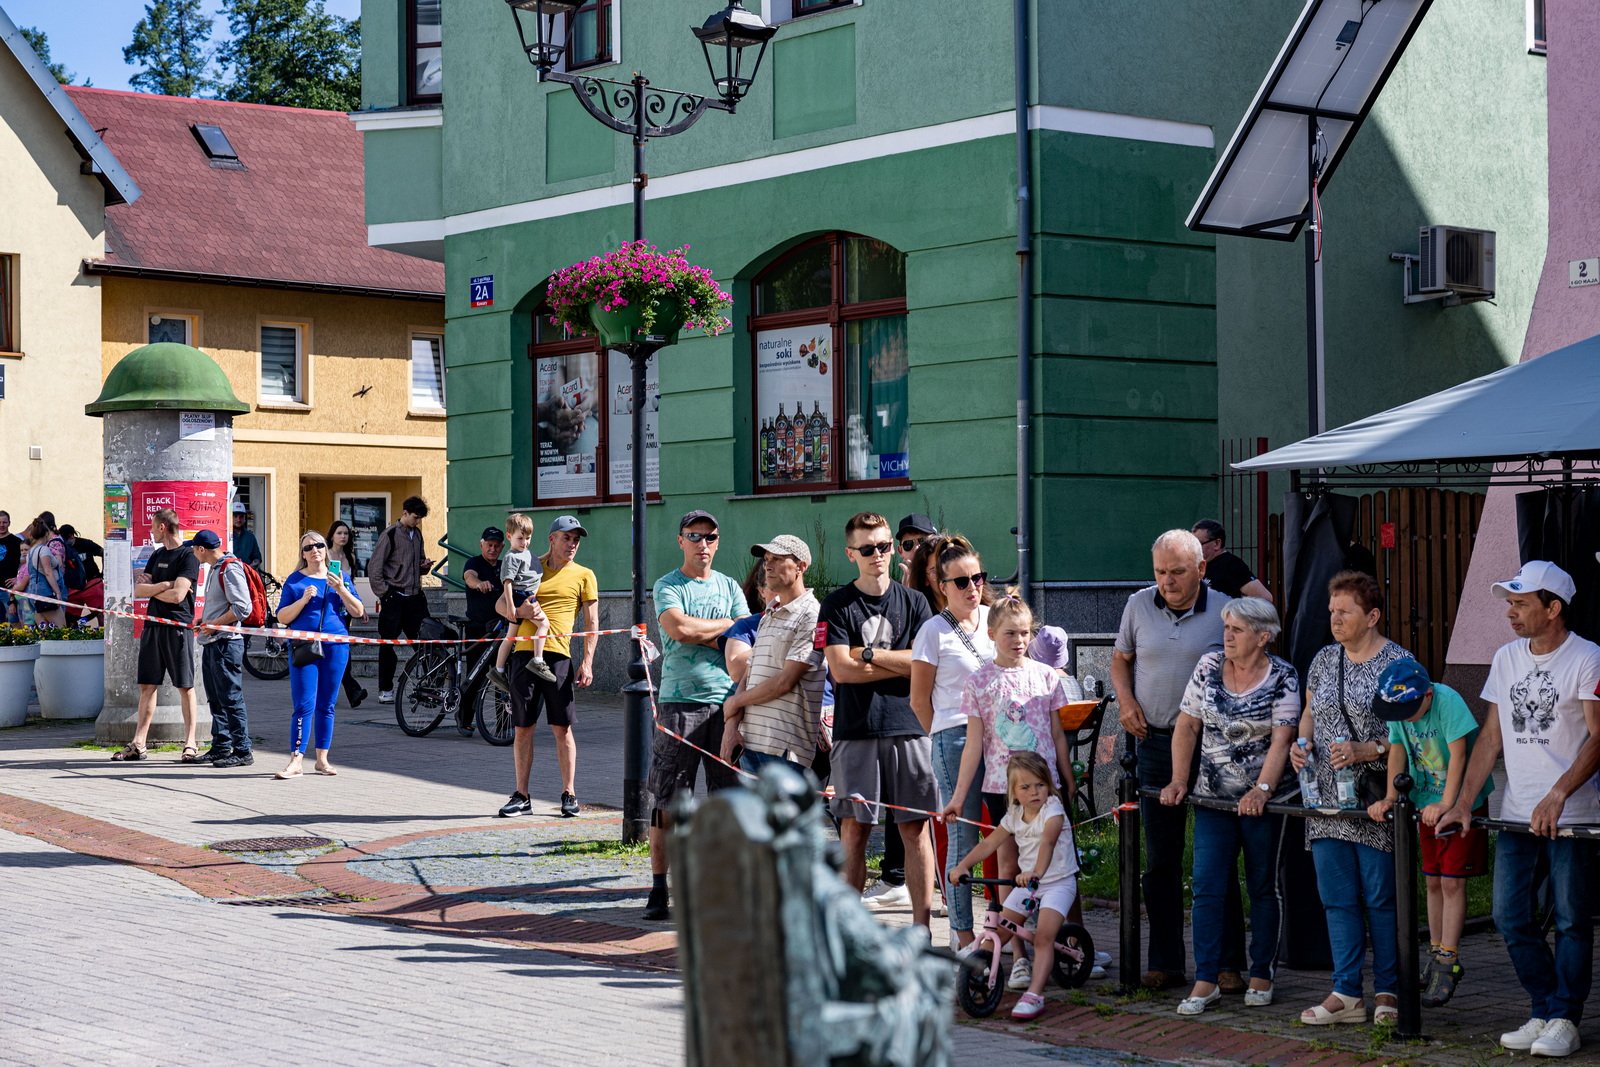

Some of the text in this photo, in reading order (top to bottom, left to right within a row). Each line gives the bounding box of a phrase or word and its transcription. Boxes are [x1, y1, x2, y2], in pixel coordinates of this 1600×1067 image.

[1579, 261, 1588, 278] 2
[475, 284, 489, 301] 2A
[759, 337, 792, 350] naturalne
[775, 348, 792, 360] soki
[539, 362, 558, 372] Acard
[562, 380, 578, 395] Acard
[539, 441, 553, 449] TERAZ
[544, 448, 559, 456] NOWYM
[880, 458, 909, 472] VICHY
[146, 497, 171, 505] BLACK
[187, 500, 224, 514] KOWARY
[1529, 737, 1550, 746] STAR
